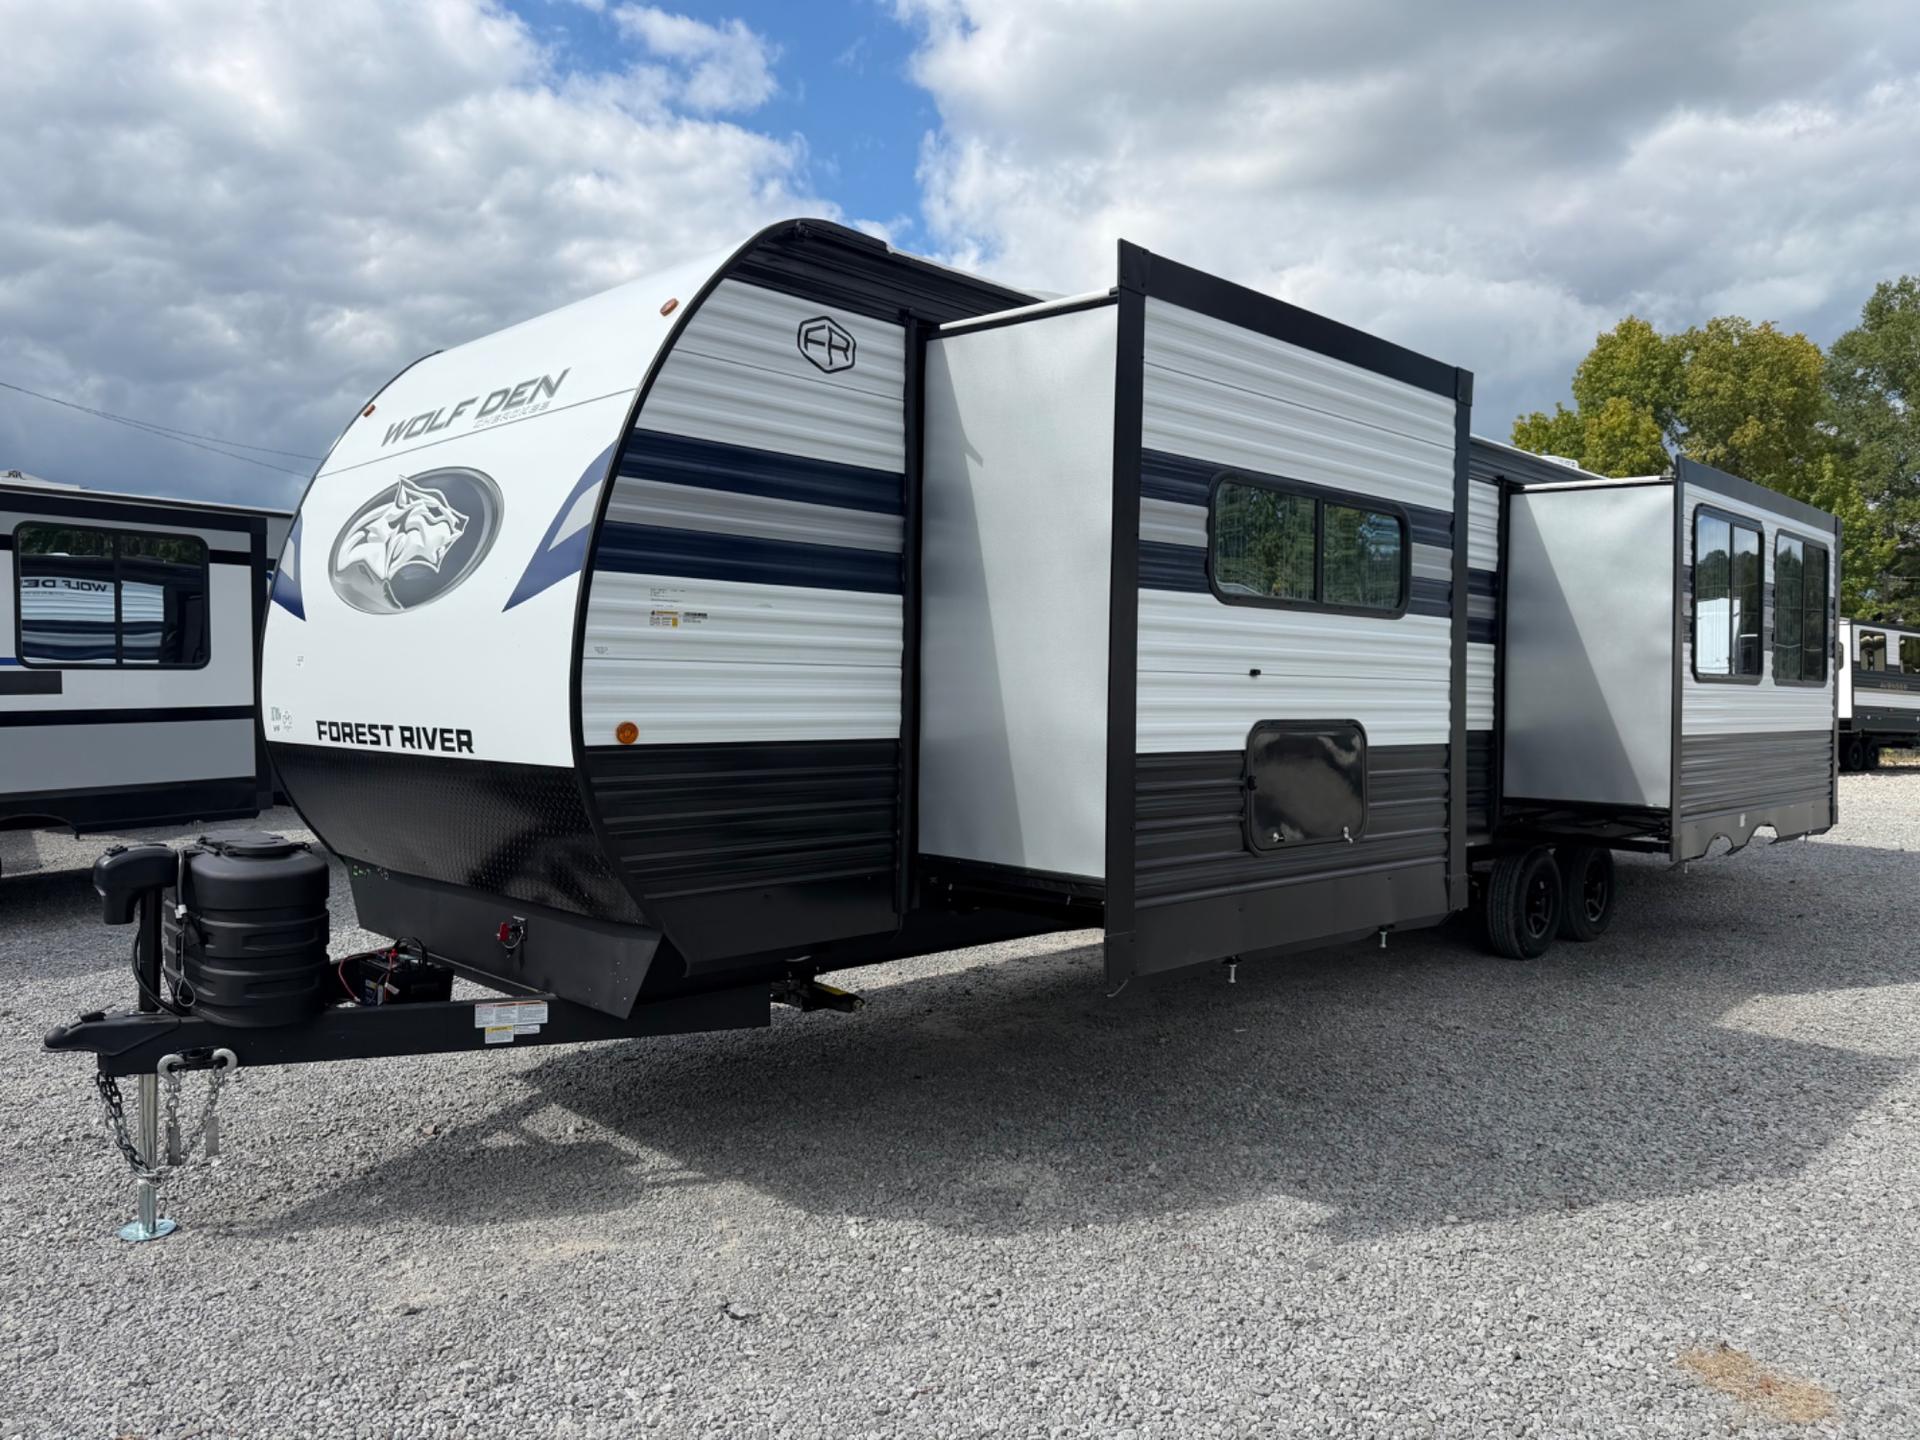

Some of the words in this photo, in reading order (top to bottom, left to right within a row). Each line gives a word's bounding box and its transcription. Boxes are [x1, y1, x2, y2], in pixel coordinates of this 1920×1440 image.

[381, 396, 479, 447] WOLF
[474, 367, 571, 419] DEN
[316, 720, 394, 747] FOREST
[398, 725, 475, 754] RIVER
